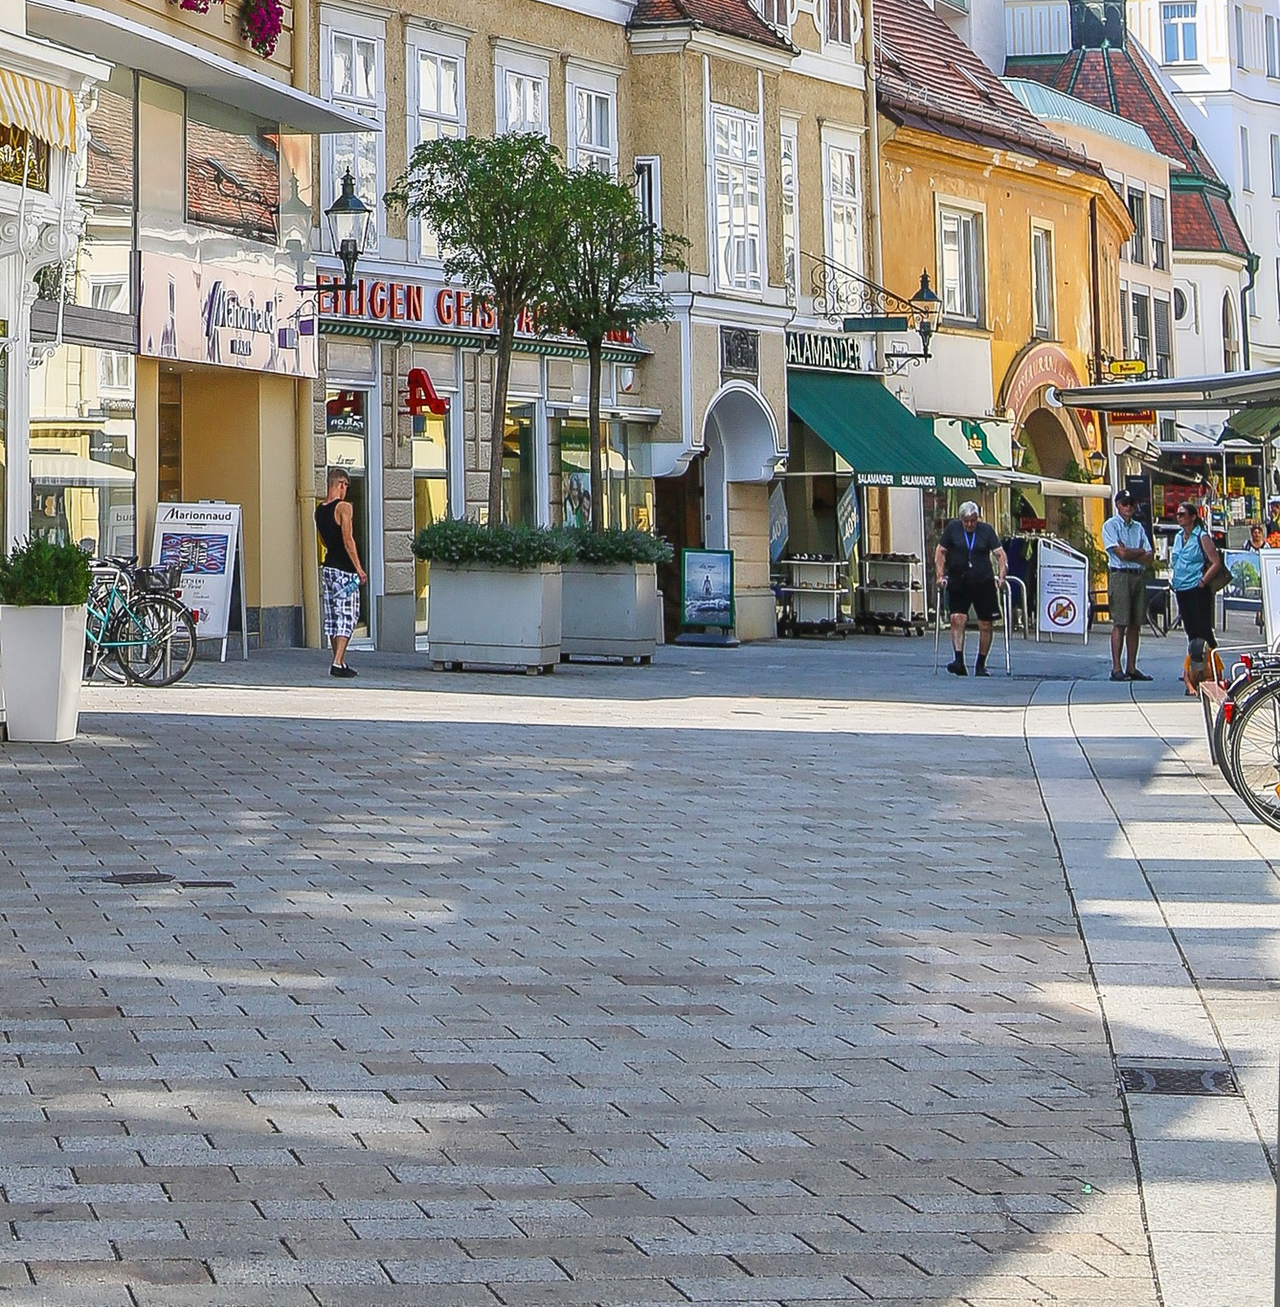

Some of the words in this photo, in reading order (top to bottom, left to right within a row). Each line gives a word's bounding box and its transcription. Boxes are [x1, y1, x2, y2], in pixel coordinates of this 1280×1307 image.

[317, 274, 424, 322] EILIGEN
[436, 287, 504, 330] GEIS
[786, 332, 862, 369] ALAMANDER
[857, 473, 894, 485] SALAMANDER
[901, 474, 936, 486] SALAMANDER
[943, 476, 977, 488] SALAMANDER
[163, 507, 232, 522] Marionnaud
